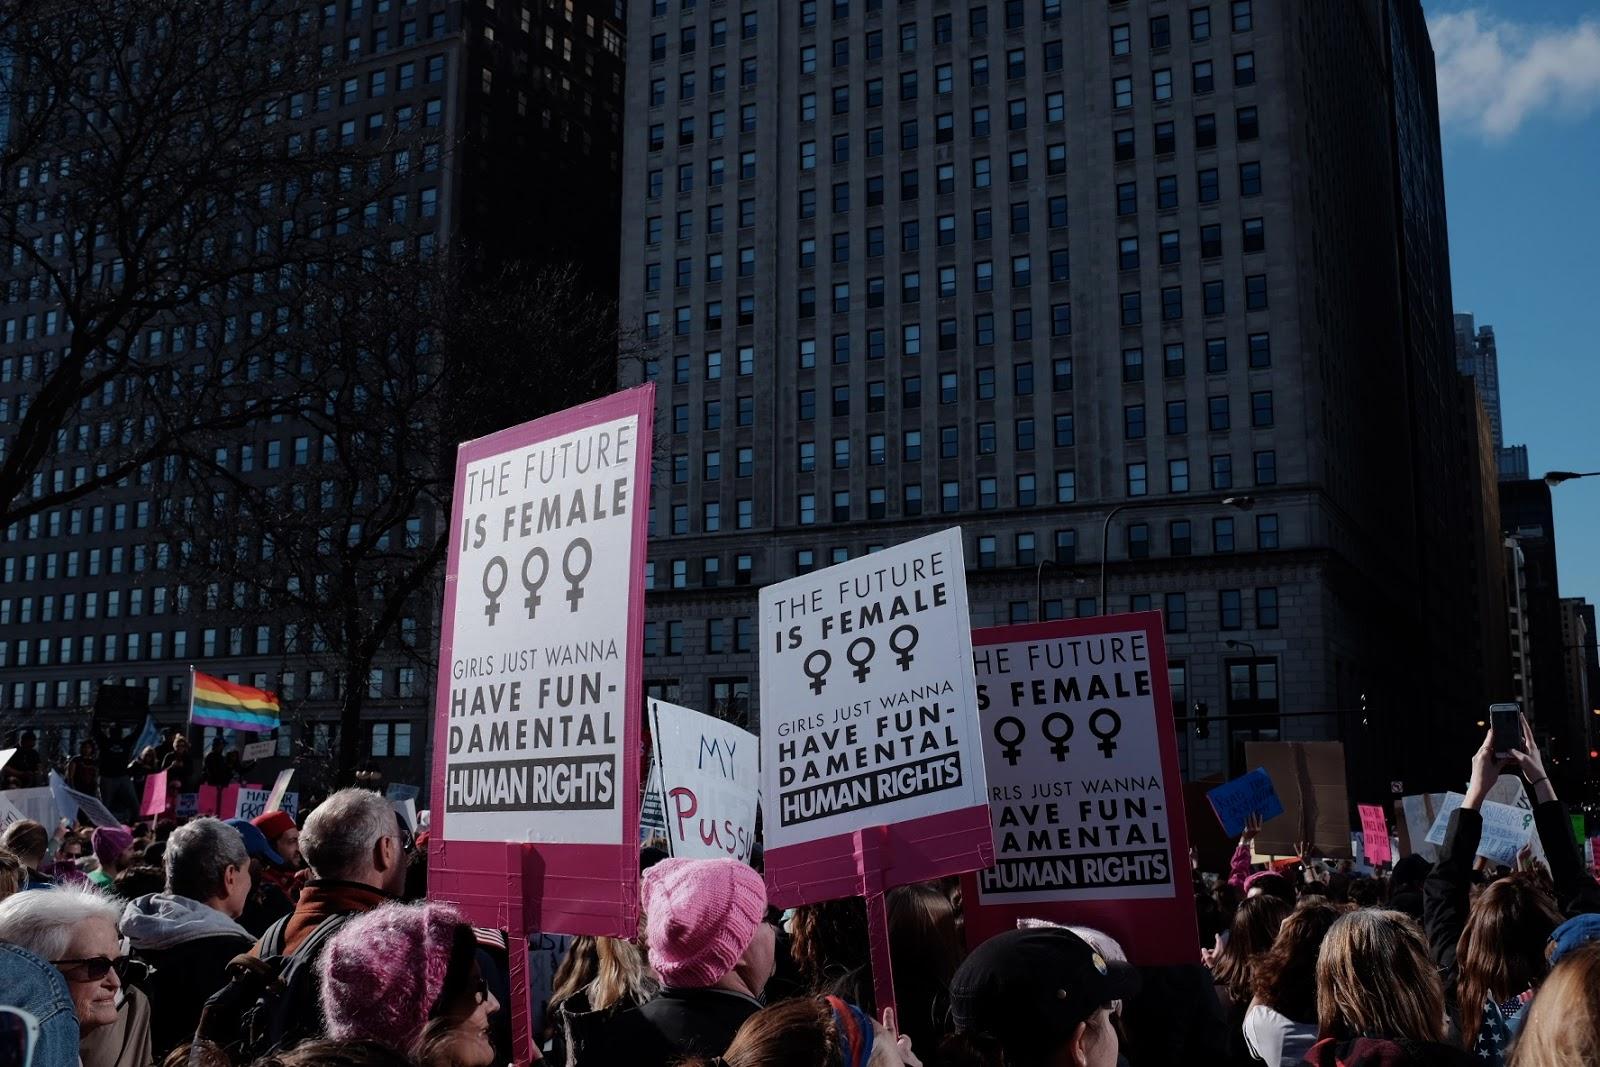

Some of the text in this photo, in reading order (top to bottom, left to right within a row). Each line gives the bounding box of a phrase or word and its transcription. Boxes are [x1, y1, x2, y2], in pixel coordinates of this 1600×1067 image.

[468, 425, 630, 504] THE FUTURE
[463, 477, 628, 552] IS FEMALE
[774, 552, 944, 622] THE FUTURE
[776, 582, 947, 653] IS FEMALE
[453, 638, 618, 680] GIRLS JUST WANNA
[972, 635, 1146, 675] HE FUTURE
[451, 672, 616, 718] HAVE FUN-
[778, 680, 954, 737] GIRLS JUST WANNA
[976, 670, 1150, 711] S FEMALE
[449, 712, 616, 755] DAMENTAL
[779, 702, 955, 762] HAVE FUN-
[698, 733, 736, 781] MY
[779, 726, 958, 788] DAMENTAL
[450, 761, 613, 806] HUMAN RIGHTS
[783, 757, 962, 822] HUMAN RIGHTS
[987, 776, 1161, 801] IRLS JUST WANNA
[1000, 797, 1162, 827] AVE FUN-
[1001, 823, 1166, 853] AMENTAL
[983, 853, 1168, 890] HUMAN RIGHTS
